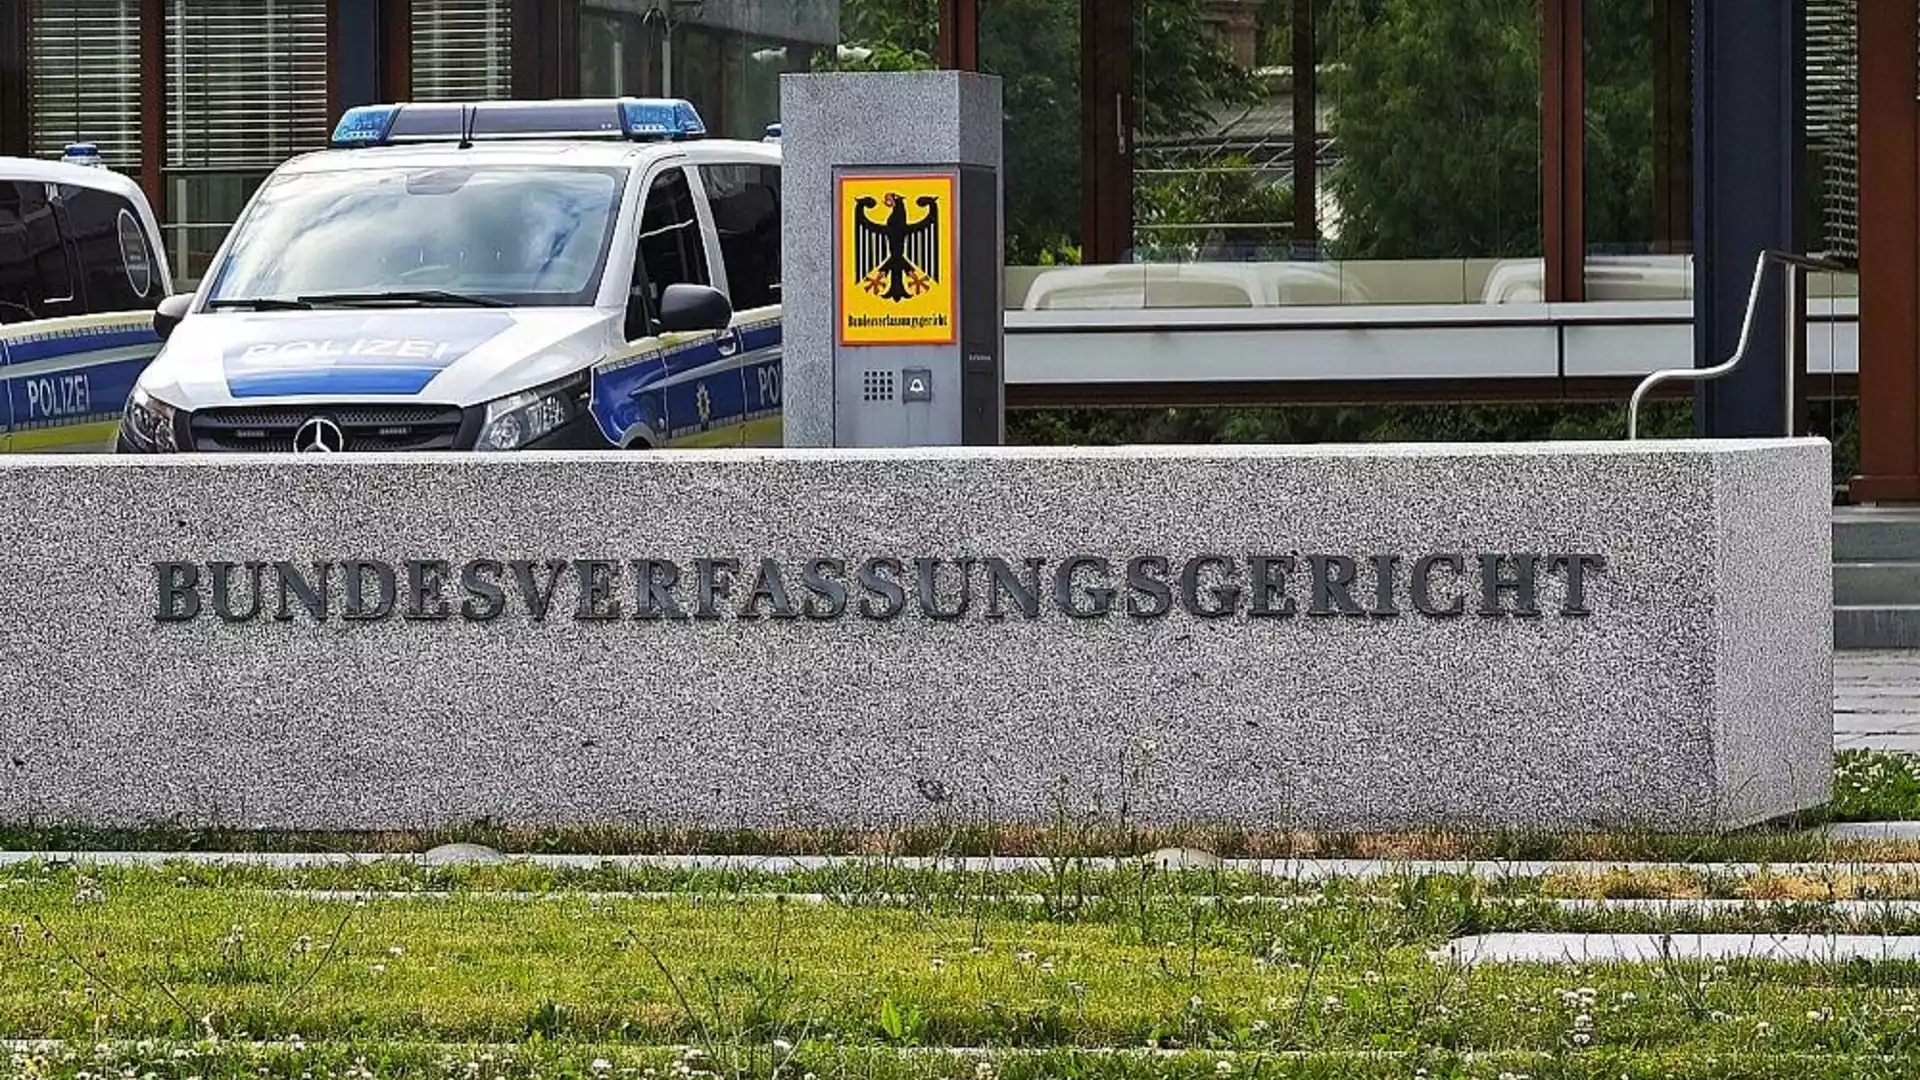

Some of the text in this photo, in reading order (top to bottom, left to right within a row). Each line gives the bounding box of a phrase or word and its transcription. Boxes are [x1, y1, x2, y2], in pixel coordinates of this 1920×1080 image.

[240, 339, 450, 365] POLIZEI
[27, 373, 90, 419] POLIZEI
[758, 362, 781, 406] PO
[153, 554, 1606, 622] BUNDESVERFASSUNGSGERICHT
